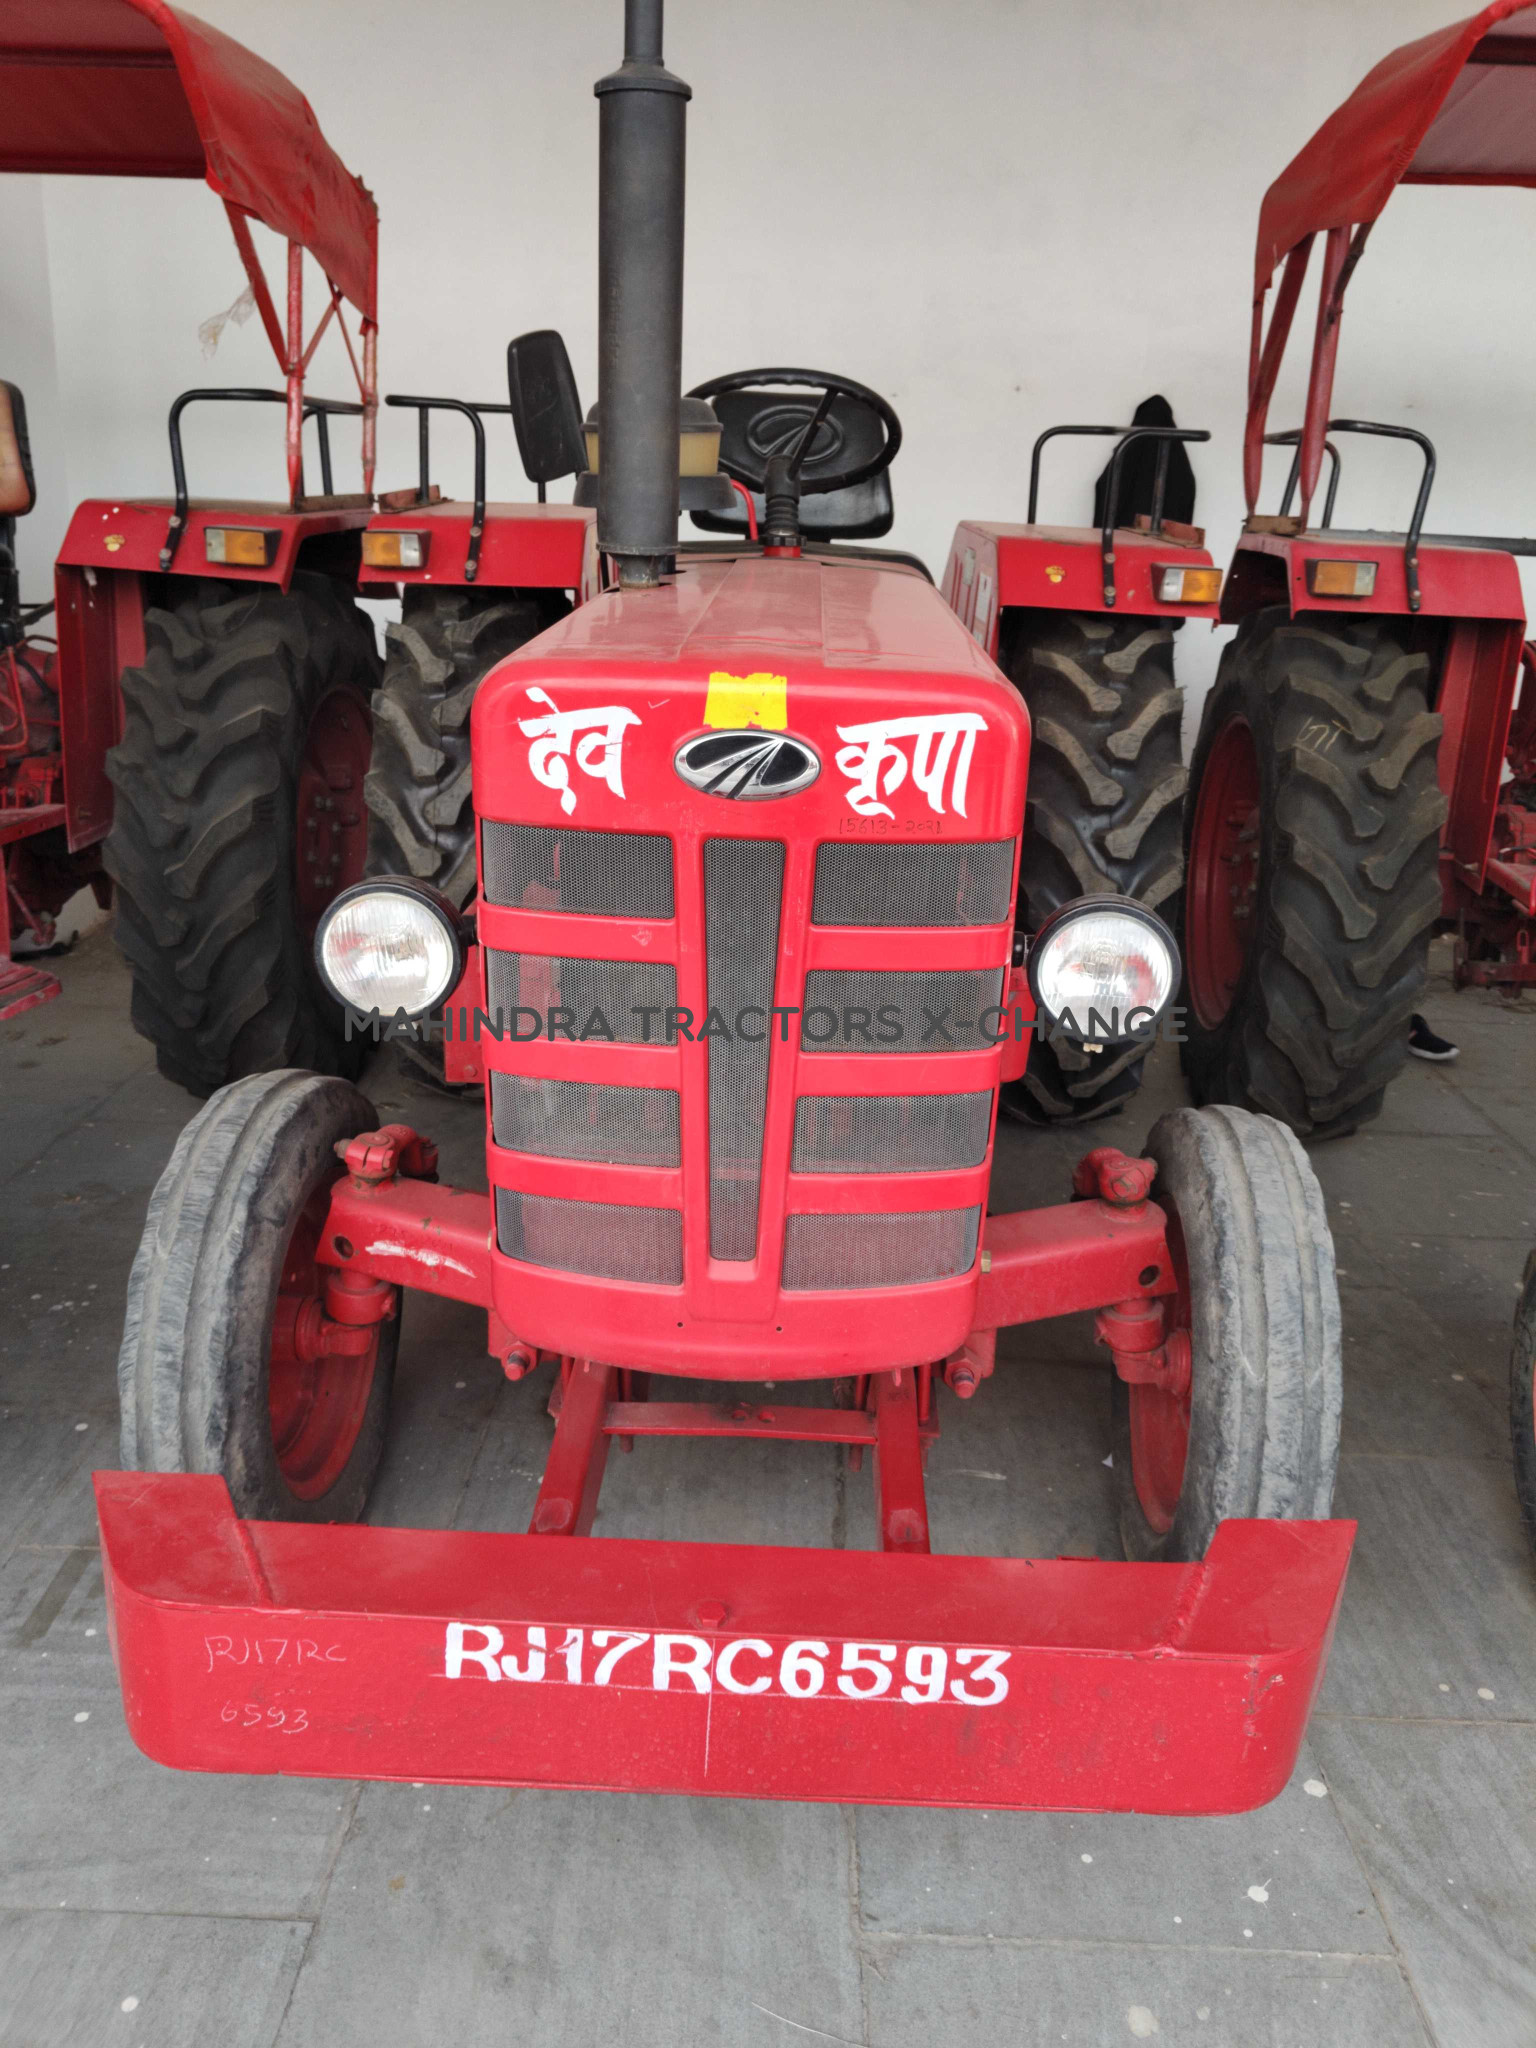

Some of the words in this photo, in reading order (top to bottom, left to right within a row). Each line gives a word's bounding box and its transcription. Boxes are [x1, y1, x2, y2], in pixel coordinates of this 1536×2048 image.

[517, 686, 643, 816] देव
[444, 1622, 1012, 1706] RJ17RC6593
[220, 1700, 308, 1734] 6593
